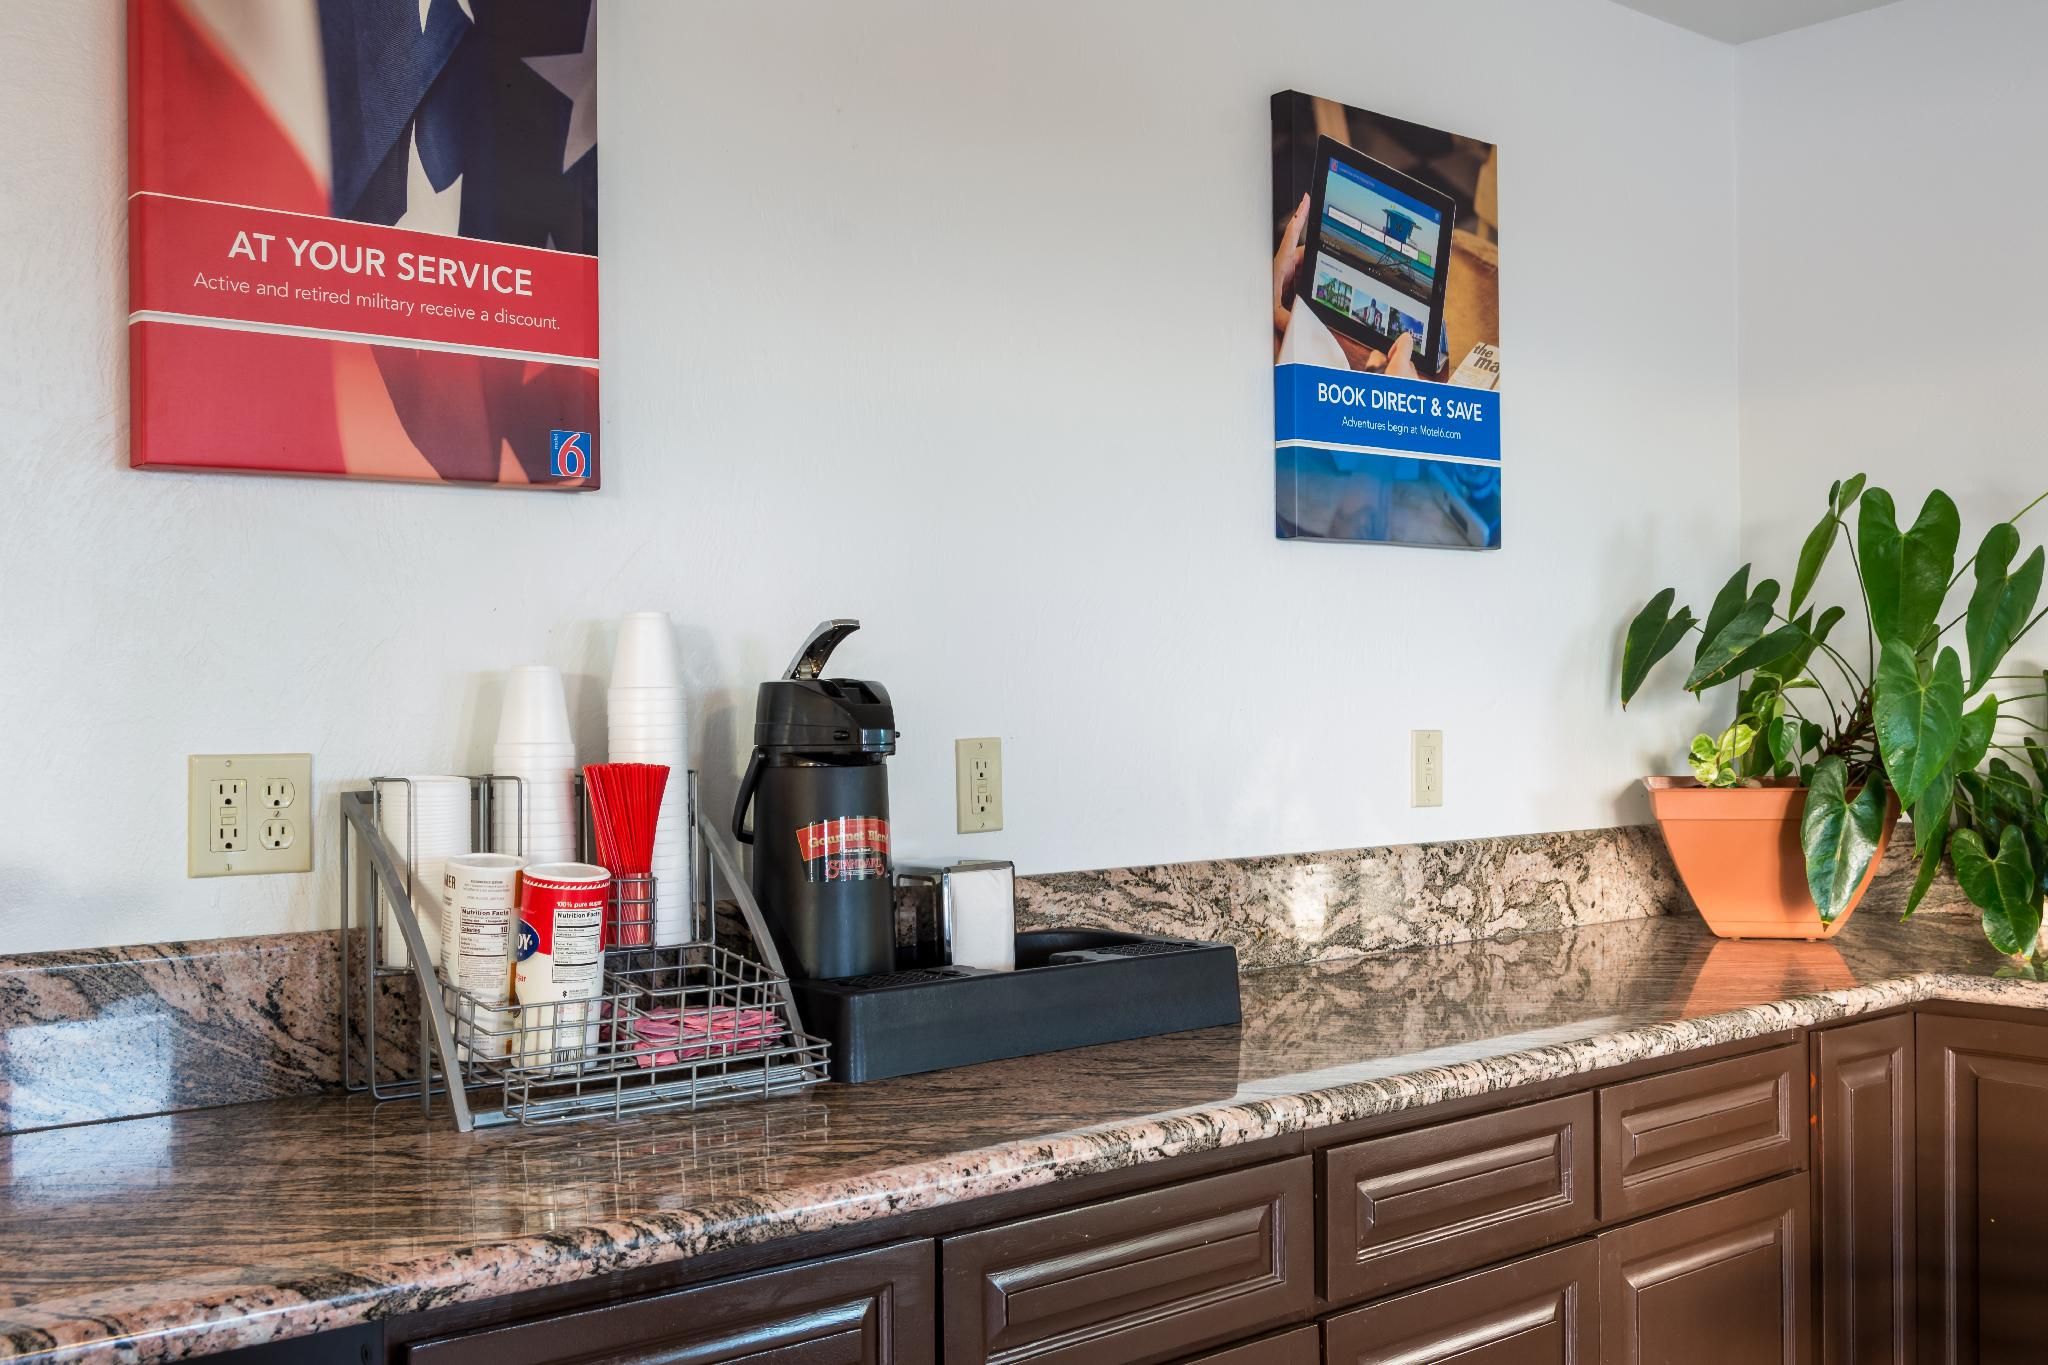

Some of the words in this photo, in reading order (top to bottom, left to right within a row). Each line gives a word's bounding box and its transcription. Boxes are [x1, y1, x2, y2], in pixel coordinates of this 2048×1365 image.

[227, 230, 276, 263] AT
[285, 237, 386, 278] YOUR
[397, 252, 533, 297] SERVICE
[193, 271, 250, 293] Active
[256, 281, 289, 298] and
[295, 286, 350, 305] retired
[356, 292, 415, 316] military
[420, 302, 475, 320] receive
[480, 310, 489, 322] a
[494, 307, 560, 330] discount.
[1473, 343, 1493, 358] the
[1317, 382, 1366, 408] BOOK
[1371, 389, 1426, 415] DIRECT
[1430, 397, 1442, 417] &
[1446, 400, 1483, 422] SAVE
[1341, 416, 1386, 431] Adventures
[1387, 423, 1409, 436] begin
[1410, 426, 1418, 435] at
[1419, 424, 1462, 440] Motel6.com
[557, 433, 586, 477] 6
[808, 830, 865, 849] Gourmet
[461, 908, 491, 917] Nutrition
[461, 926, 481, 934] Calories
[500, 926, 508, 934] 10
